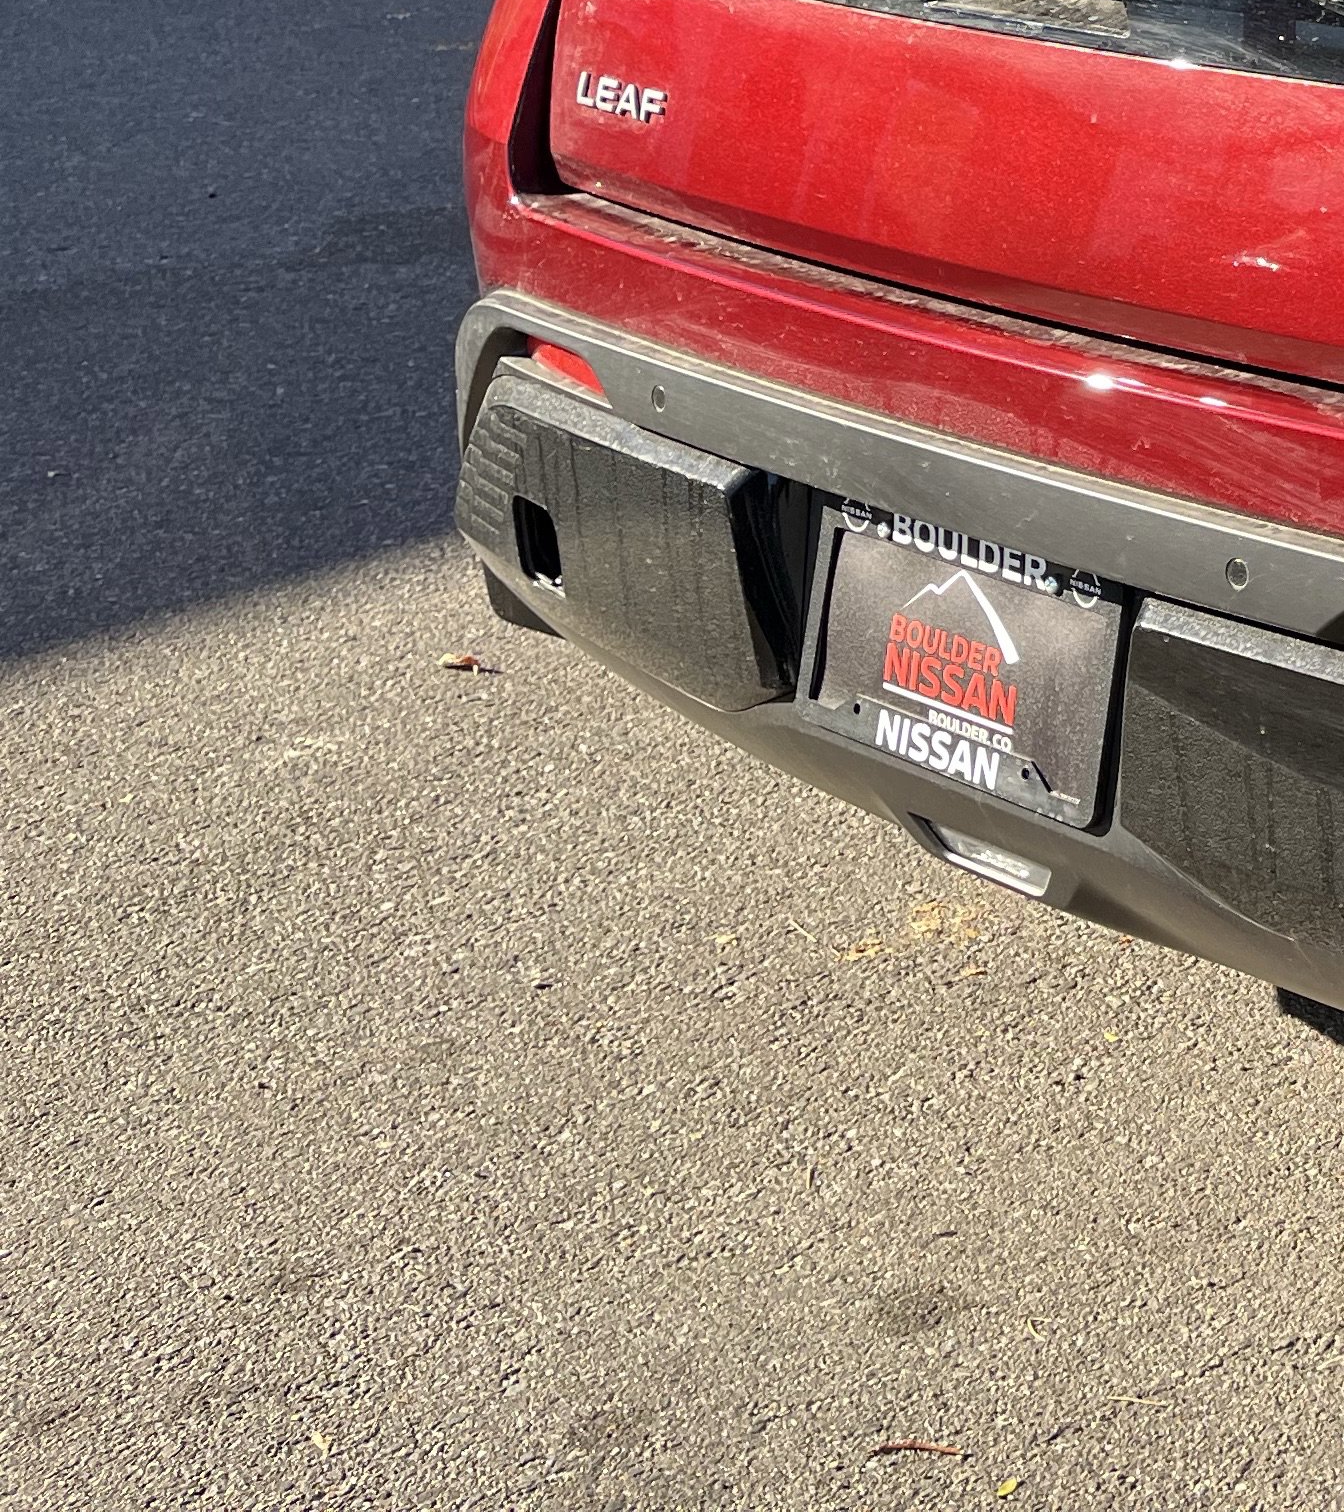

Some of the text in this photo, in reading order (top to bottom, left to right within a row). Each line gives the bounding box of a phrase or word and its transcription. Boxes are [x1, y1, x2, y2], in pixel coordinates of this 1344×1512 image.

[576, 71, 668, 124] LEAF
[892, 512, 1048, 591] BOULDER
[889, 613, 1001, 676] BOULDER
[883, 642, 1018, 727] NISSAN
[875, 708, 1000, 791] NISSAN
[992, 733, 1012, 754] CO
